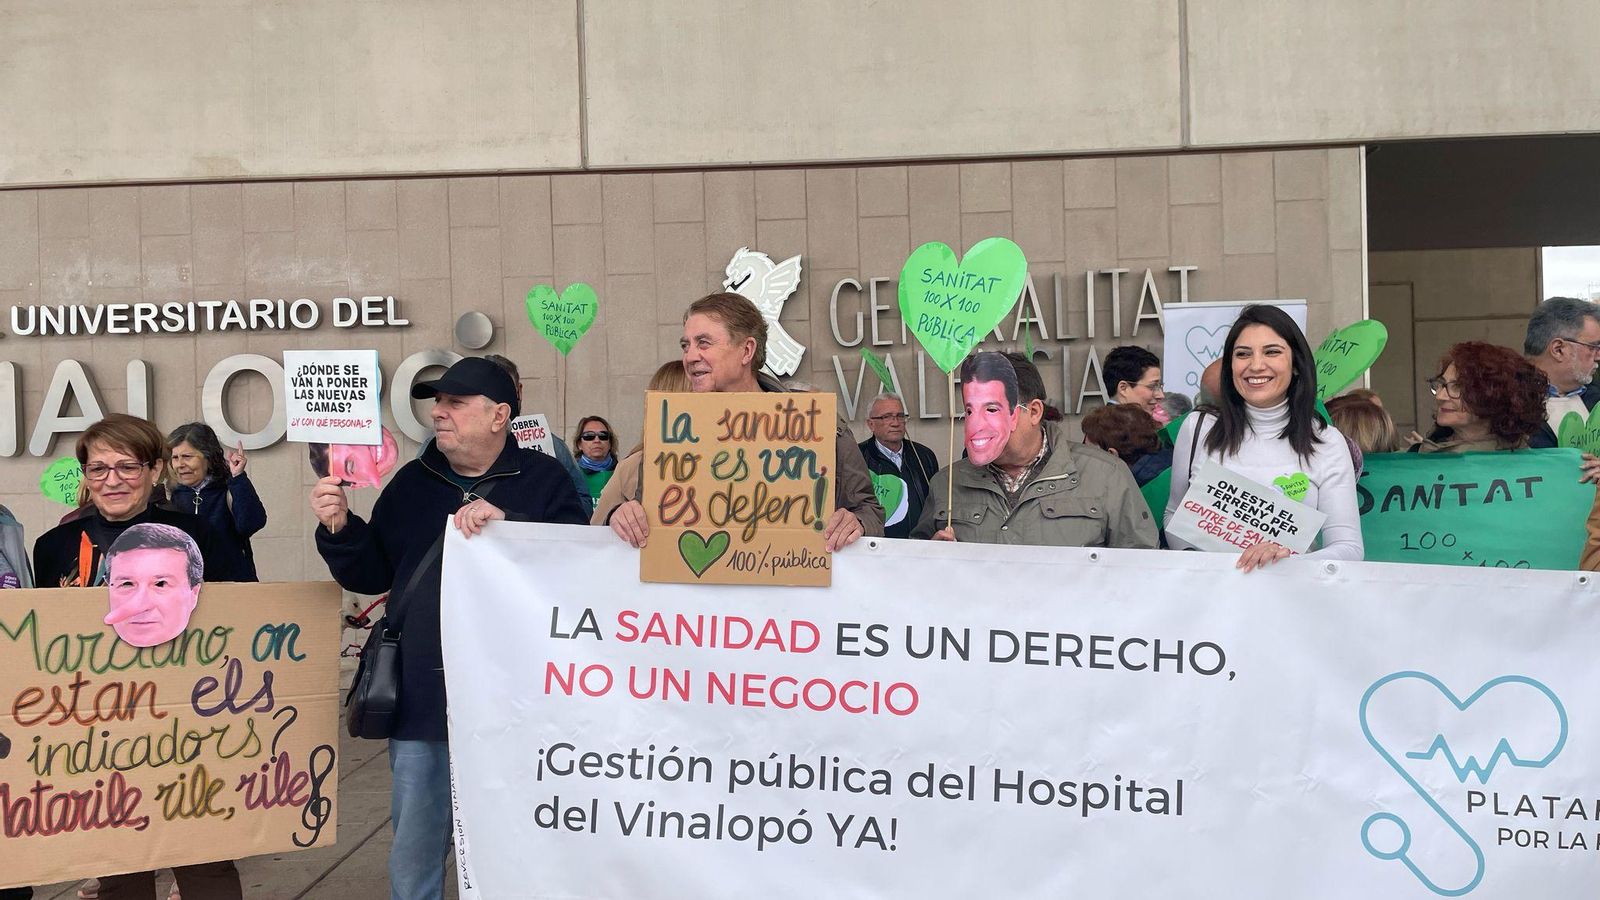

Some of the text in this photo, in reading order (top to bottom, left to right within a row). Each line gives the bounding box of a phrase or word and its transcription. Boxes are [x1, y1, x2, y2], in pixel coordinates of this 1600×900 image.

[10, 295, 410, 336] UNIVERSITARIO DEL
[291, 377, 368, 389] VAN A PONER
[297, 361, 360, 378] ¿DÓNDE SE
[294, 389, 366, 401] LAS NUEVAS
[306, 401, 352, 413] CAMAS?
[301, 418, 315, 427] CON
[329, 418, 373, 429] PERSONAL?
[661, 398, 824, 444] La sanitat
[654, 450, 701, 484] no
[710, 448, 750, 483] es
[658, 484, 702, 528] es
[1183, 500, 1228, 527] CENTRE
[1226, 520, 1245, 533] DE
[1206, 484, 1299, 536] TERRENY PER
[1211, 500, 1281, 538] AL SEGON
[1217, 480, 1239, 496] ON
[1277, 508, 1296, 524] EL
[1400, 531, 1457, 550] 100
[771, 546, 831, 577] pública
[251, 621, 307, 663] on
[549, 606, 1237, 681] LA SANIDAD ES UN DERECHO,
[11, 657, 275, 727] estan els
[544, 661, 920, 717] NO UN NEGOCIO
[154, 763, 236, 821] rile,
[536, 742, 1184, 818] ¡Gestión pública del Hospital
[534, 795, 898, 852] del Vinalopó YA!
[1497, 827, 1550, 849] POR
[1557, 831, 1588, 851] LA
